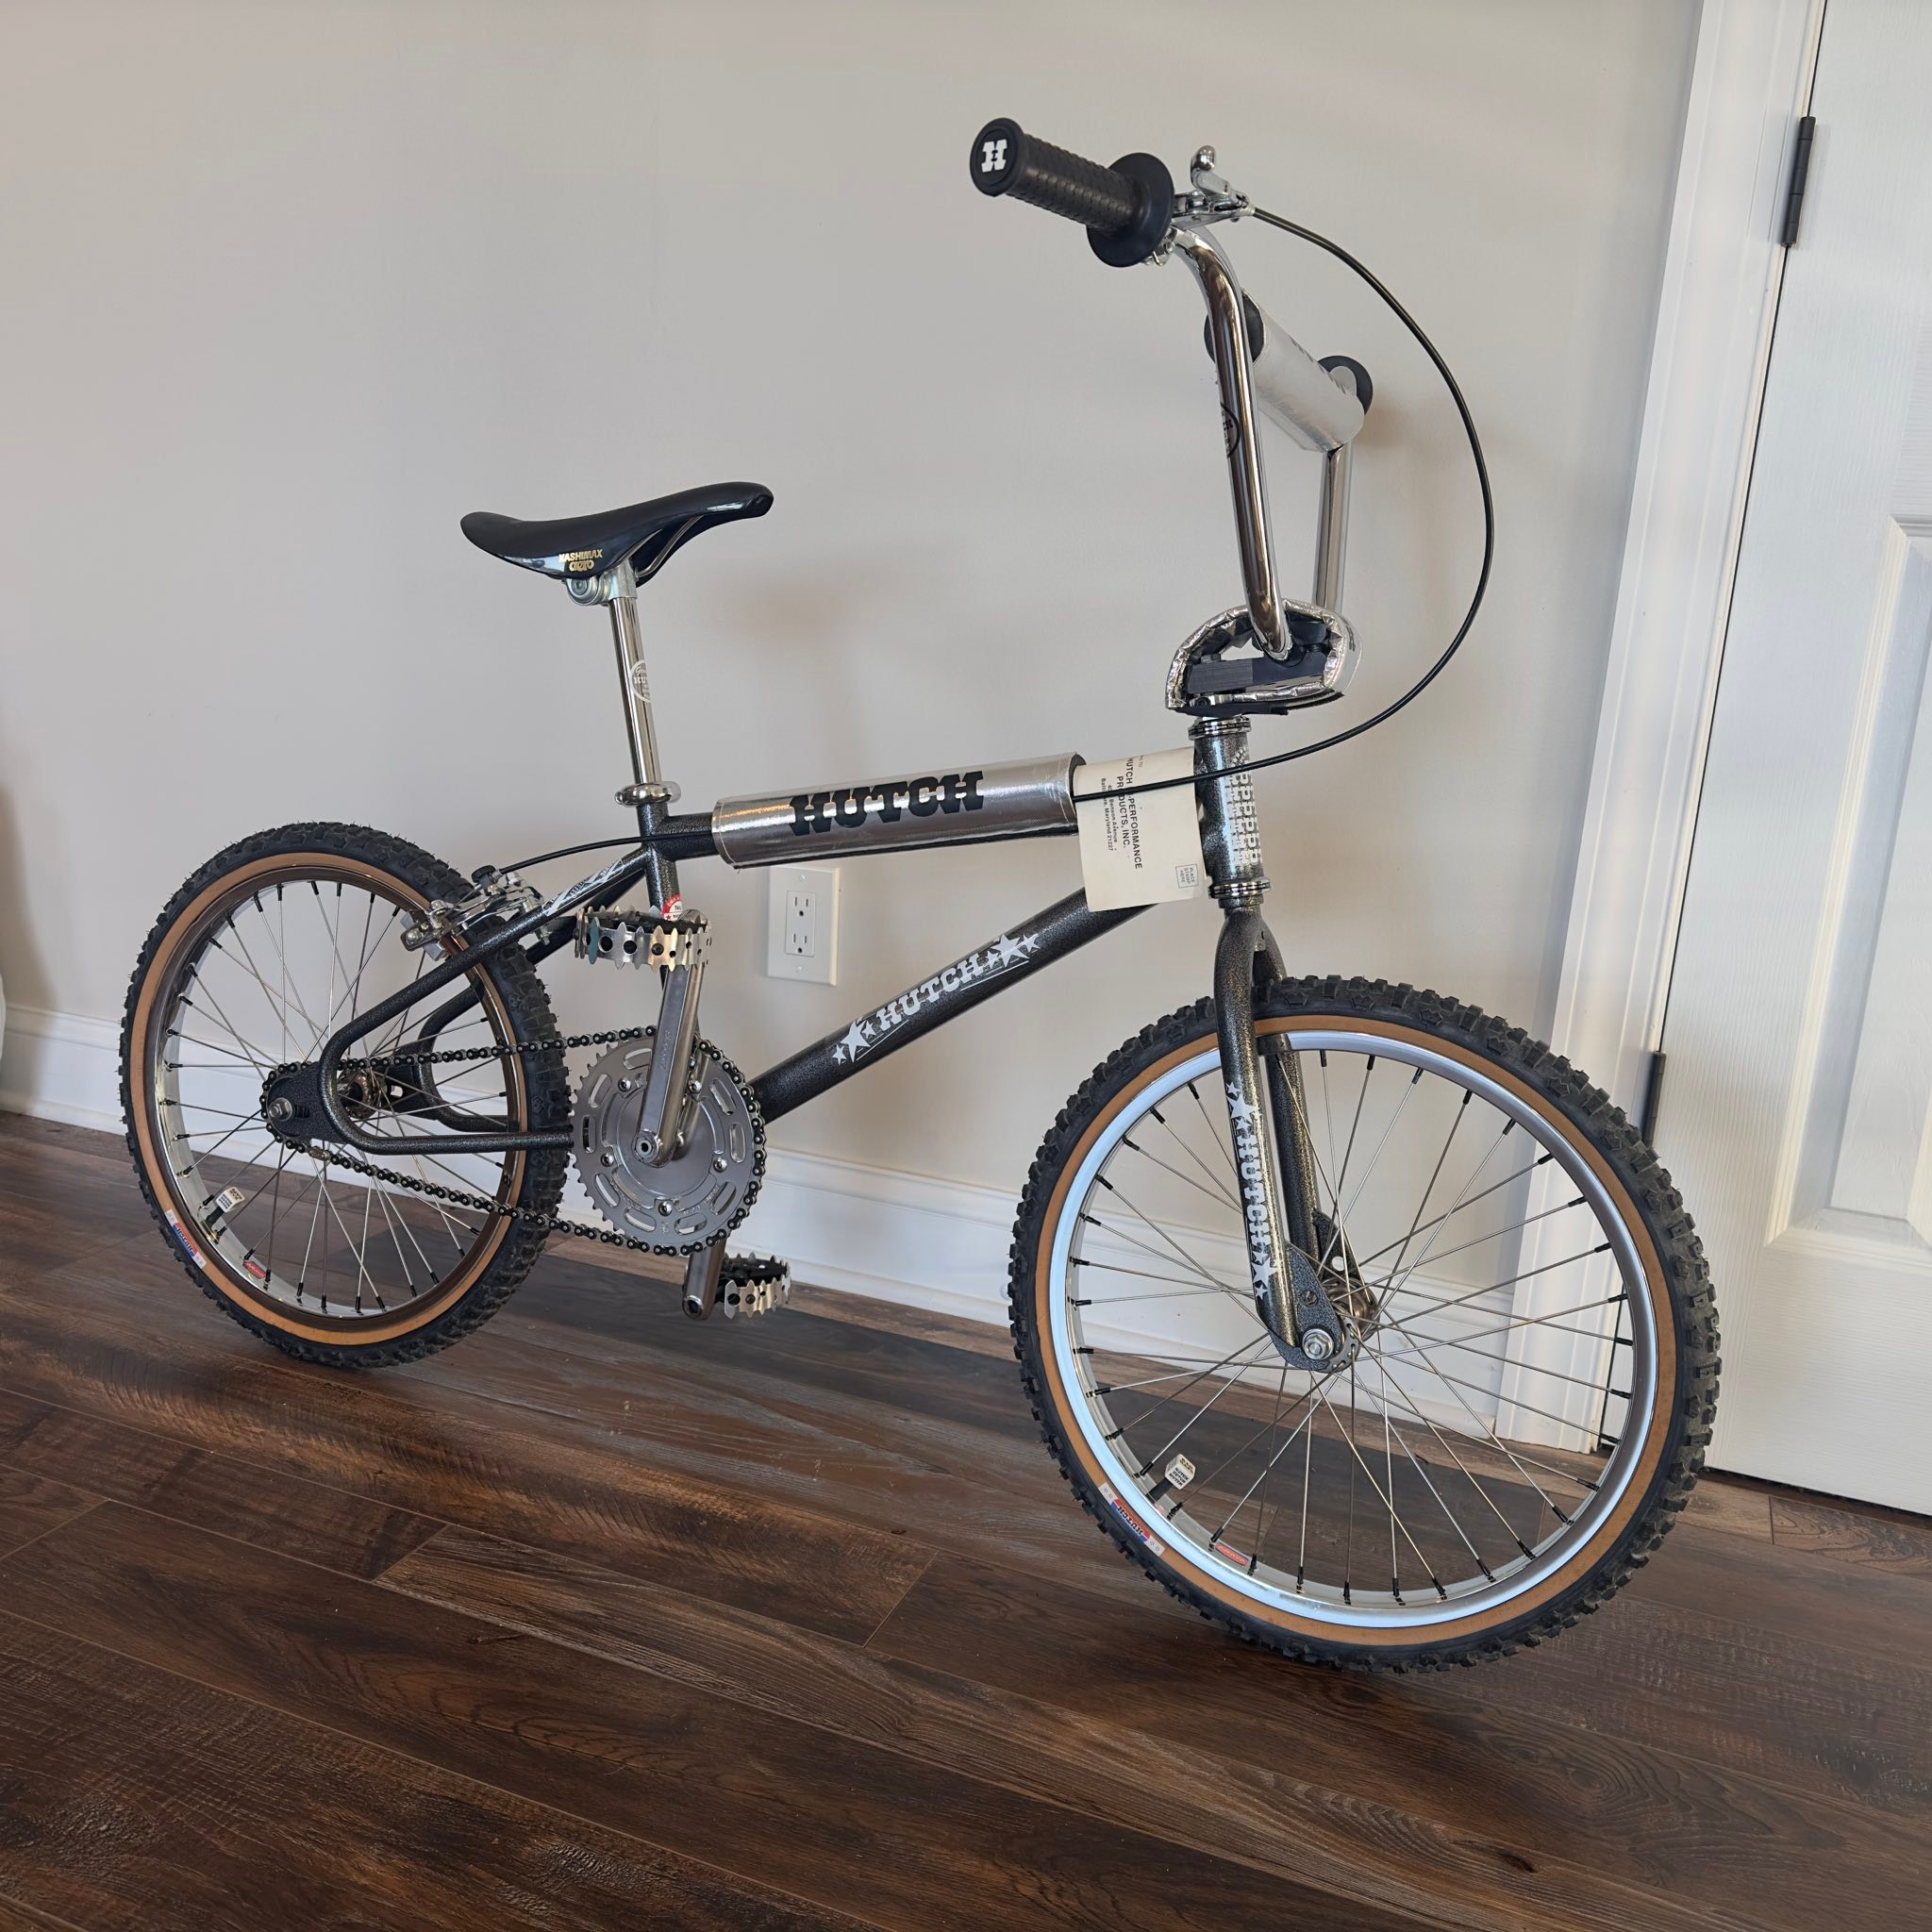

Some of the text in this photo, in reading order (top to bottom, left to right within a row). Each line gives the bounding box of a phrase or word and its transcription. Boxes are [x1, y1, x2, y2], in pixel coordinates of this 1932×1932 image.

[558, 549, 603, 563] KASHIMAX
[789, 771, 984, 837] HUTCH
[1117, 776, 1128, 827] PRDUCTS,
[1127, 792, 1142, 869] -PERFORMANCE
[876, 953, 985, 1031] HUTCH
[1237, 1134, 1271, 1248] HUTCH
[1117, 1506, 1144, 1536] HUTCH
